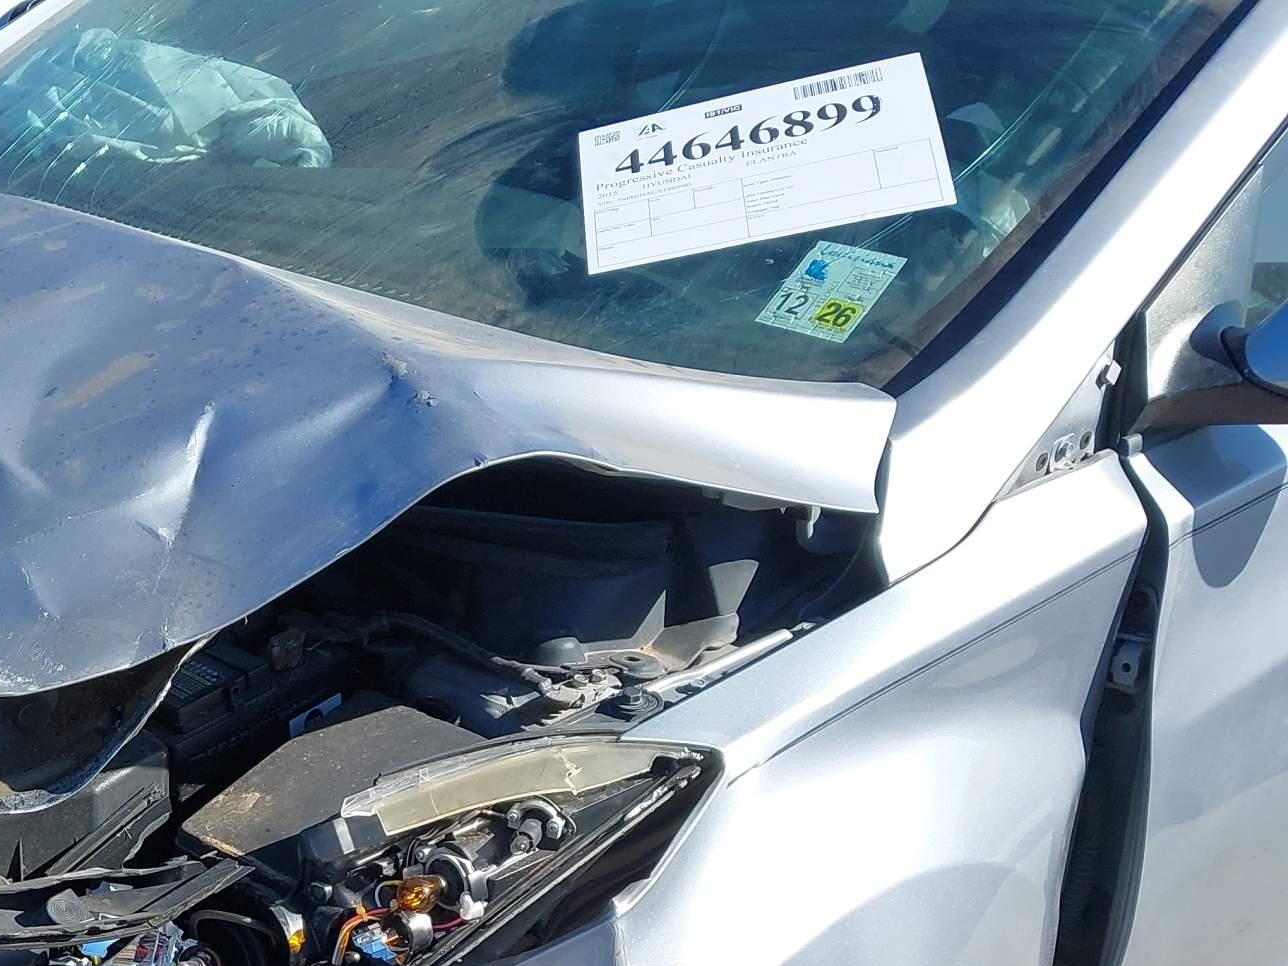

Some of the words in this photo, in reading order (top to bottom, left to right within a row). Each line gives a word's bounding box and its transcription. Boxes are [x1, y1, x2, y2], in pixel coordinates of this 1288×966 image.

[615, 94, 882, 174] 44646899
[596, 169, 674, 191] Progressive
[678, 154, 736, 173] Casualty
[741, 138, 808, 159] Insurance
[642, 174, 692, 190] HYUNDAI
[776, 292, 811, 316] 12
[816, 302, 857, 328] 26
